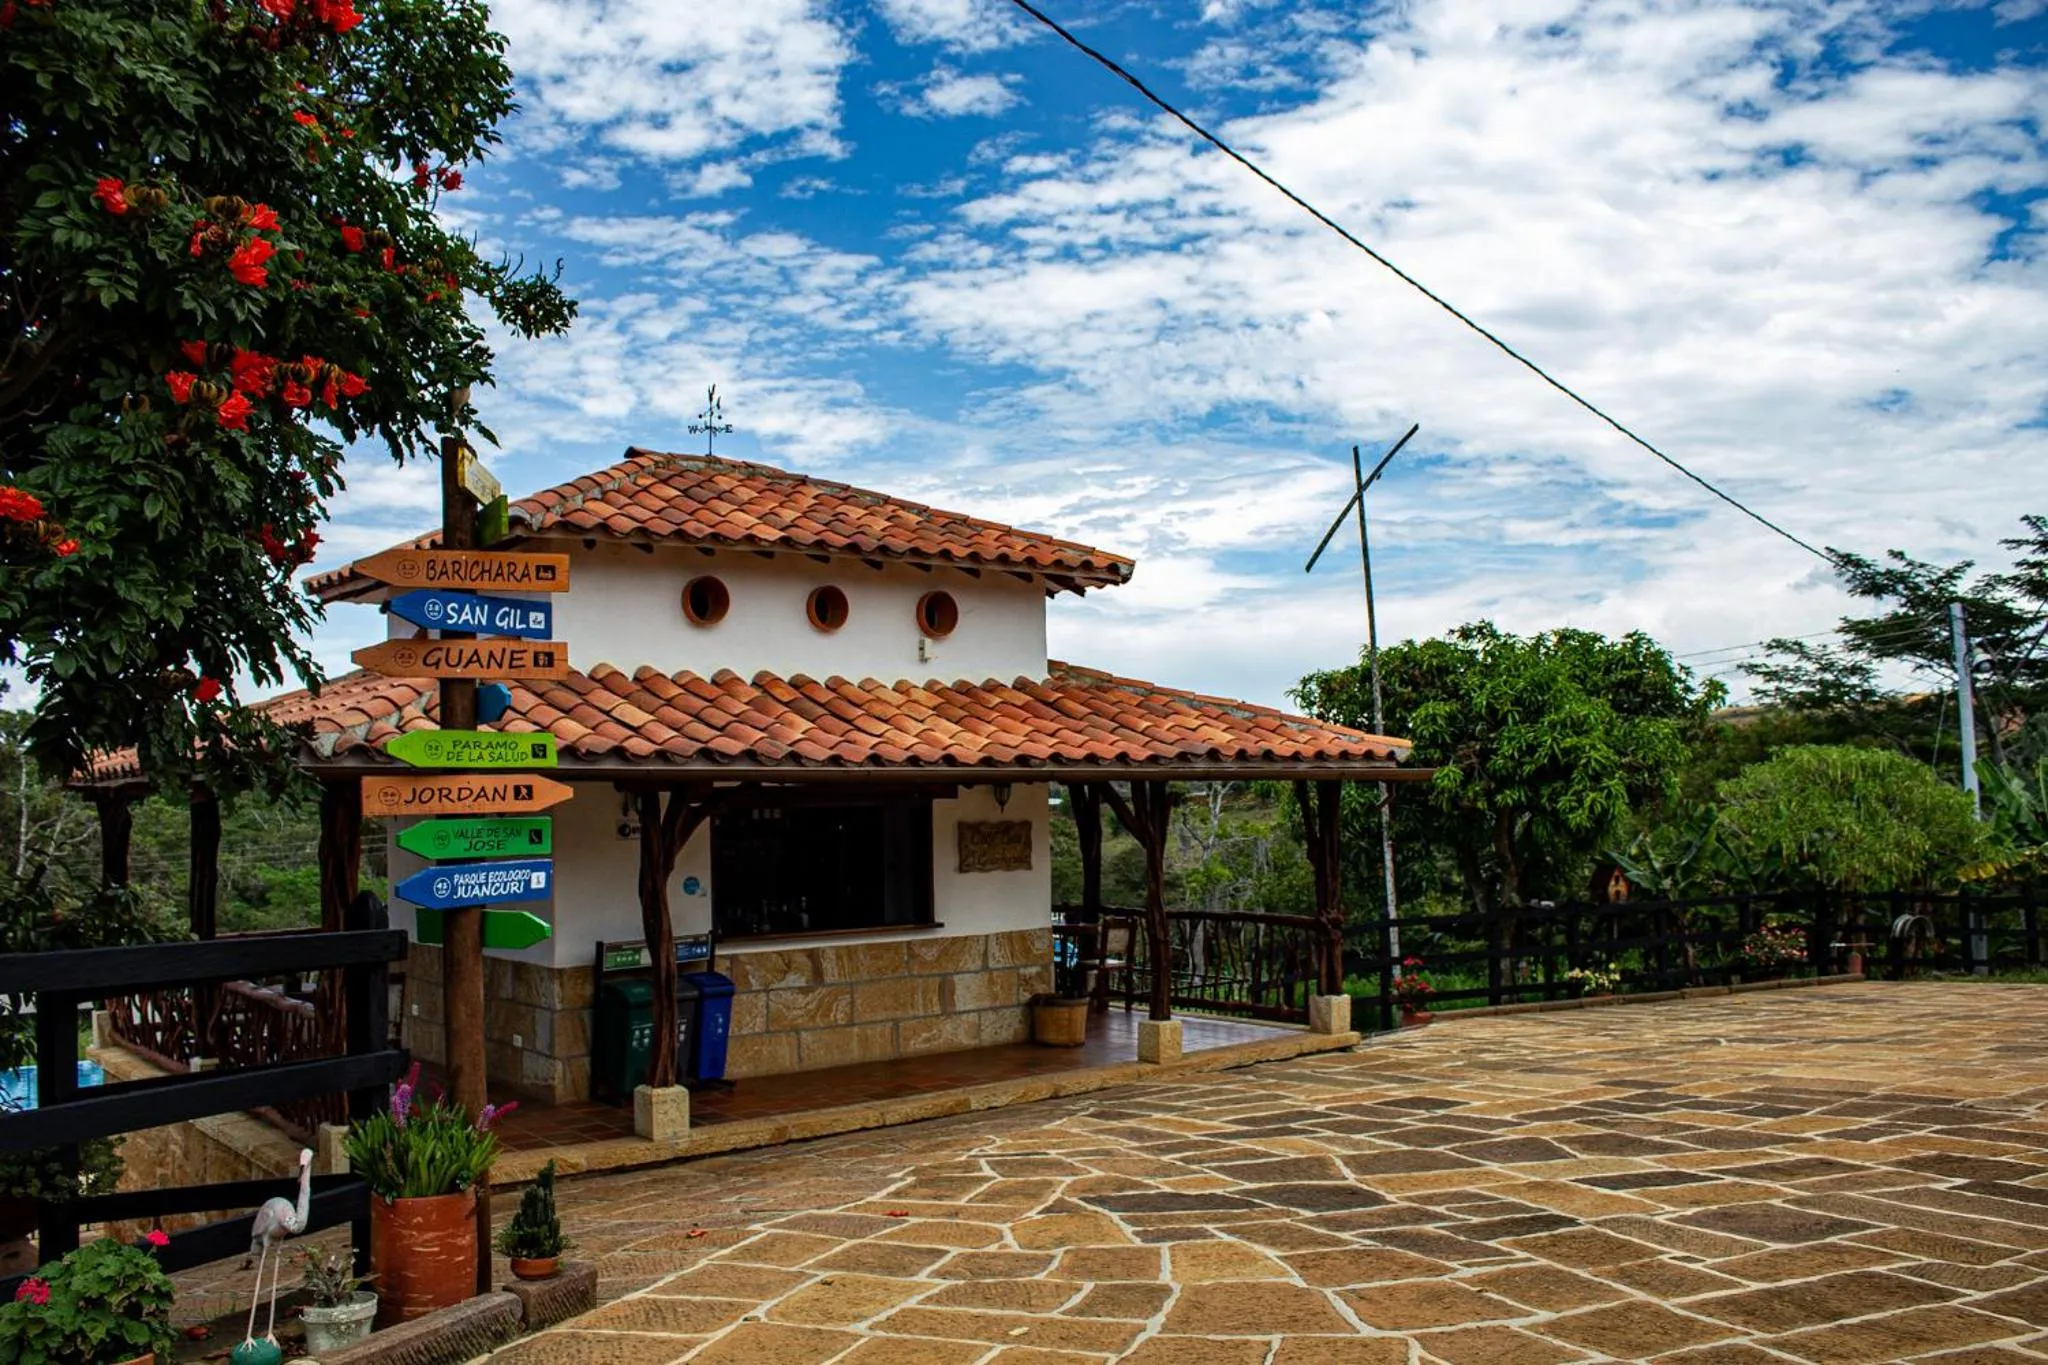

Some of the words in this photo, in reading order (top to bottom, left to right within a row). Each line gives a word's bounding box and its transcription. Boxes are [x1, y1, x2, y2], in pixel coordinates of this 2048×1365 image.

[426, 559, 532, 582] BARICHARA
[446, 603, 488, 625] SAN
[495, 606, 527, 629] GIL
[422, 647, 528, 669] GUANE
[452, 740, 518, 751] PARAMO
[446, 751, 463, 761] DE
[468, 751, 484, 762] LA
[488, 751, 528, 762] SALUD
[404, 785, 508, 804] JORDAN
[453, 827, 483, 839] VALLE
[485, 827, 500, 838] DE
[503, 826, 523, 838] SAN
[464, 840, 505, 852] JOSE
[454, 872, 487, 886] PARQUE
[453, 880, 524, 898] JUANCURI
